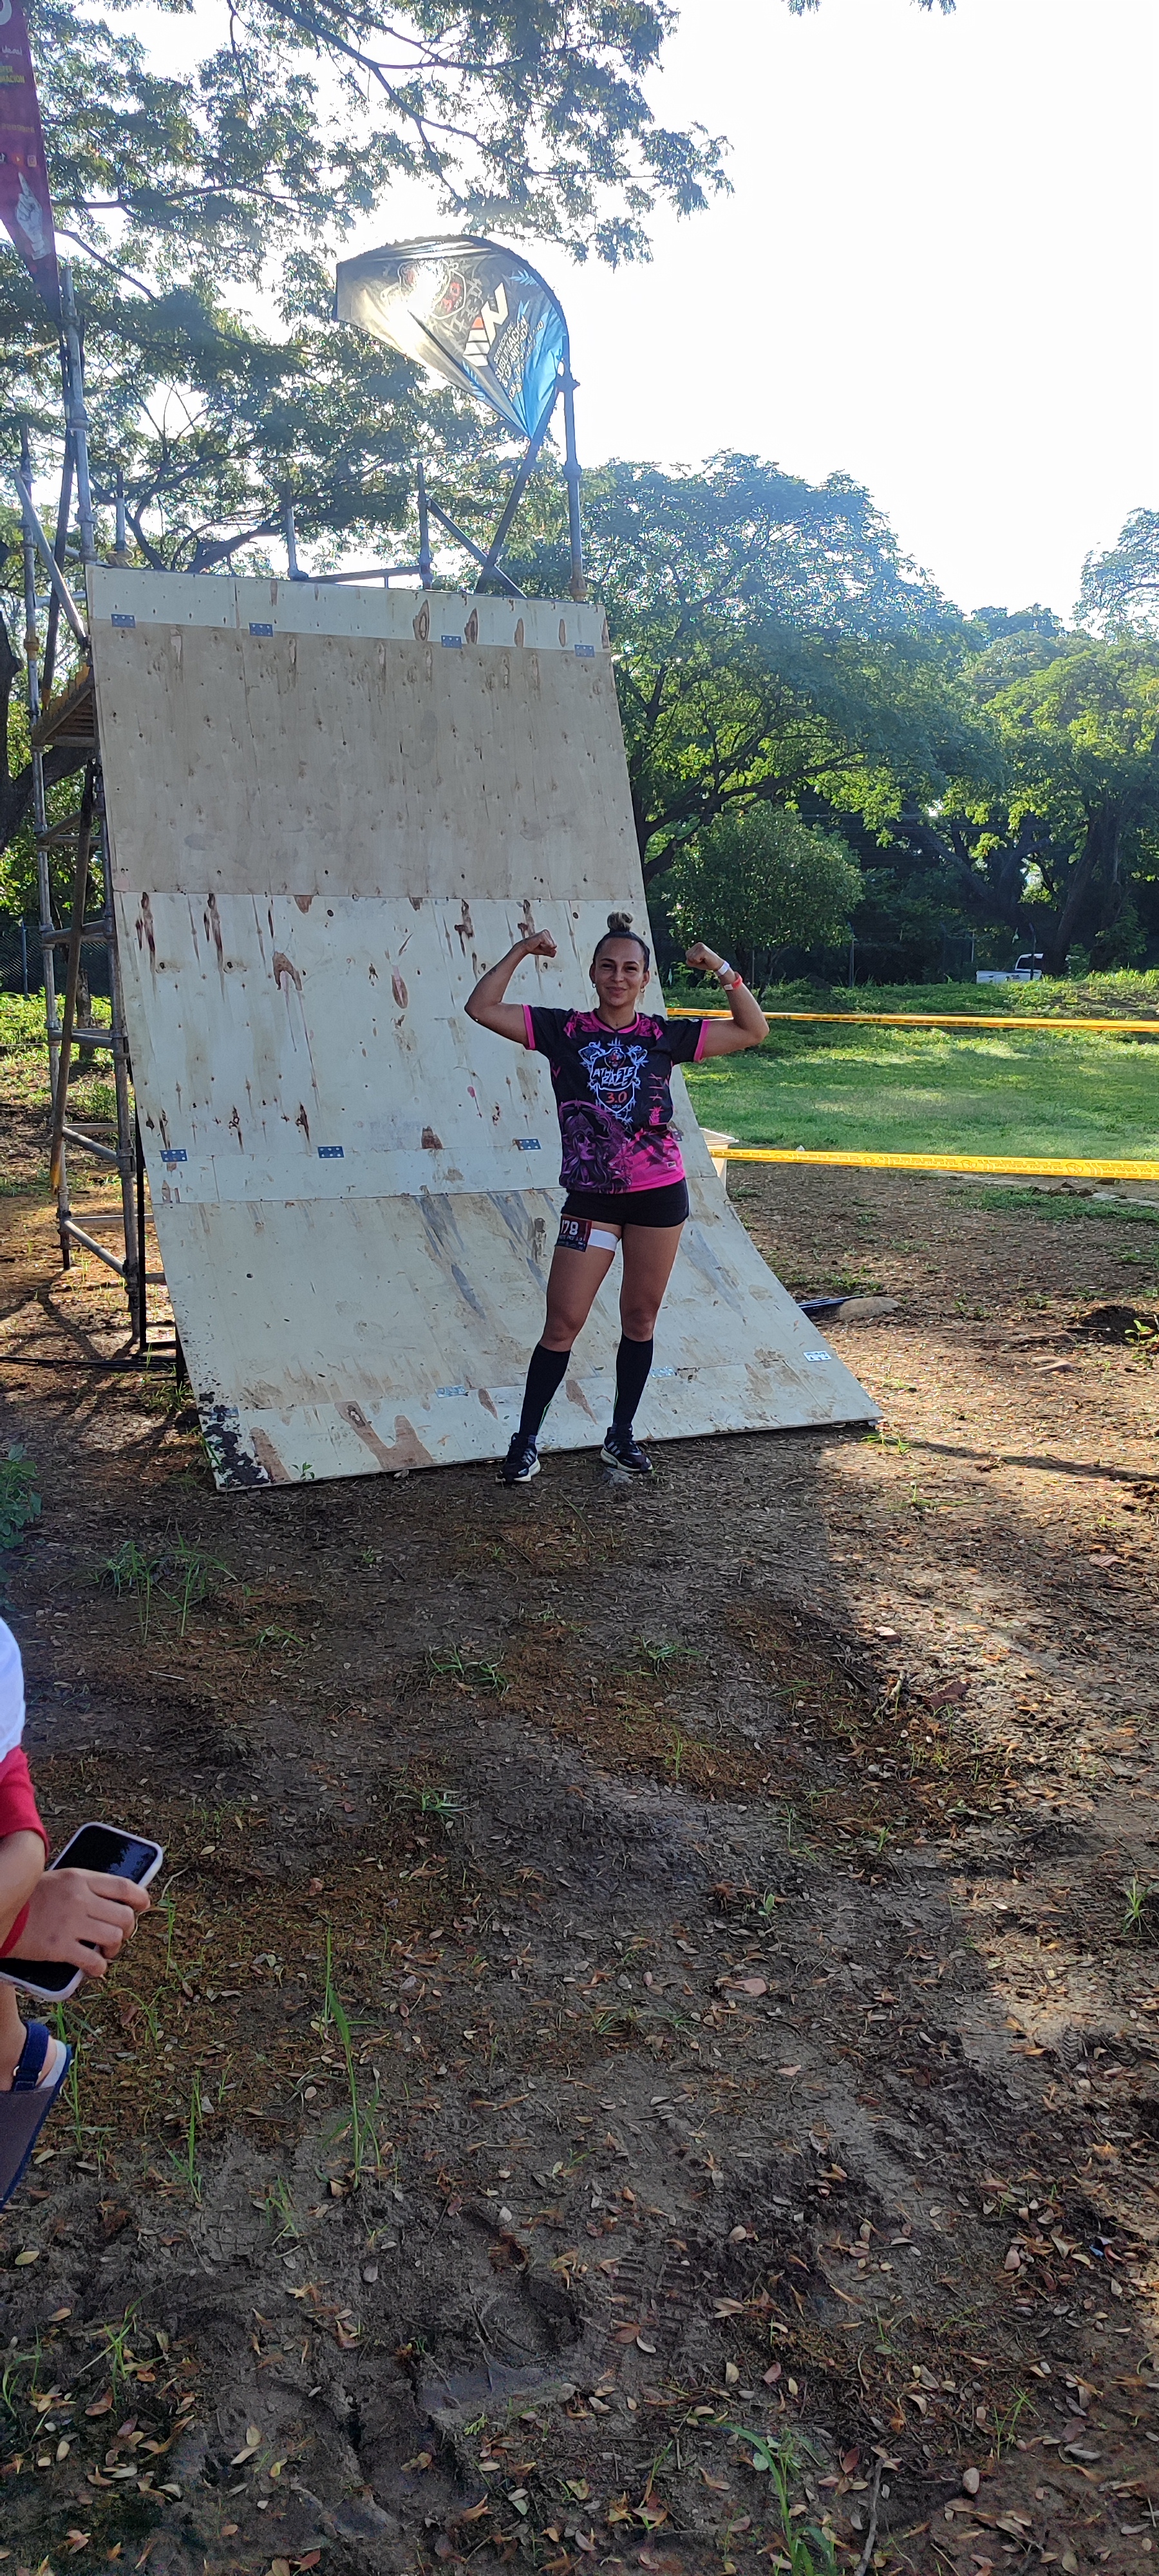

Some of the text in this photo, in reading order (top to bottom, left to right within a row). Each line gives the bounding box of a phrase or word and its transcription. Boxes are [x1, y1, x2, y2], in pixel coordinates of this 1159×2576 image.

[504, 323, 530, 379] CAANDADO
[592, 1066, 635, 1078] ATHLETE
[605, 1092, 627, 1103] 3.0
